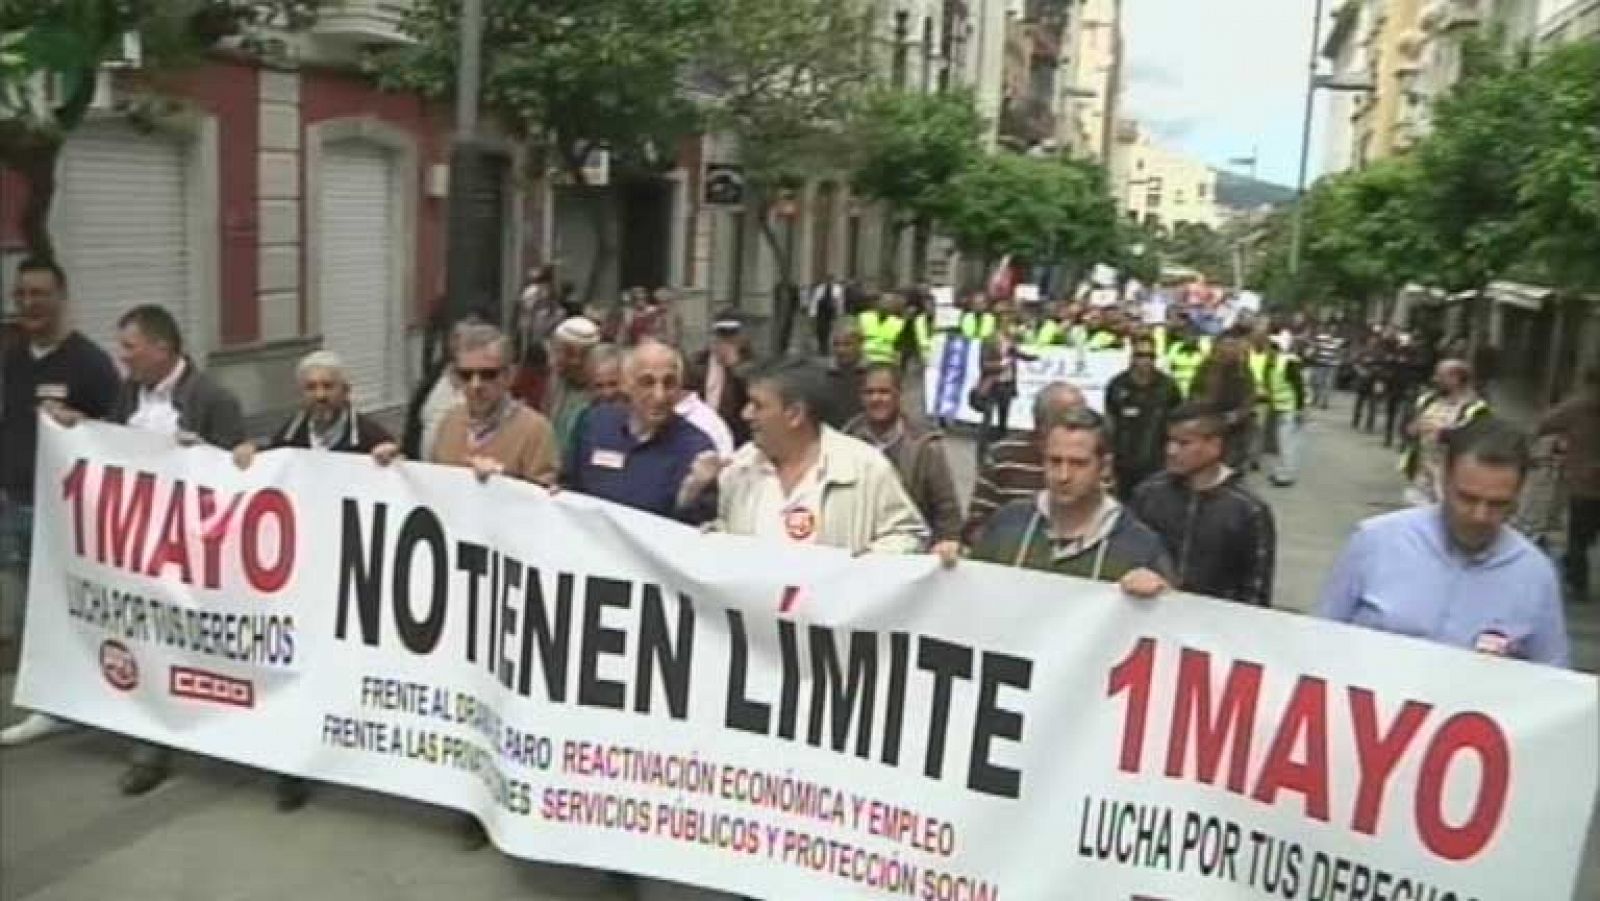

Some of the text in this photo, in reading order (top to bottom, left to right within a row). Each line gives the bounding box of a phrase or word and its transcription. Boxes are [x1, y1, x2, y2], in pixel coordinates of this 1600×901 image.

[96, 466, 297, 592] MAYO
[187, 609, 296, 664] DERECHOS
[335, 497, 448, 655] NO
[455, 541, 695, 722] TIENEN
[724, 586, 1034, 799] LÍMITE
[322, 714, 388, 753] FRENTE
[390, 726, 402, 753] A
[404, 727, 437, 763] LAS
[542, 787, 652, 833] SERVICIOS
[656, 796, 760, 855] PÚBLICOS
[766, 824, 780, 858] Y
[783, 829, 918, 896] PROTECCIÓN
[361, 676, 430, 716] FRENTE
[431, 687, 452, 722] AL
[504, 727, 552, 770] PARO
[564, 740, 716, 795] REACTIVACIÓN
[721, 767, 844, 826] ECONÓMICA
[851, 794, 866, 829] Y
[868, 801, 955, 858] EMPLEO
[1164, 647, 1511, 861] MAYO
[1079, 796, 1172, 870] LUCHA
[1177, 811, 1242, 882] POR
[1248, 831, 1303, 900] TUS
